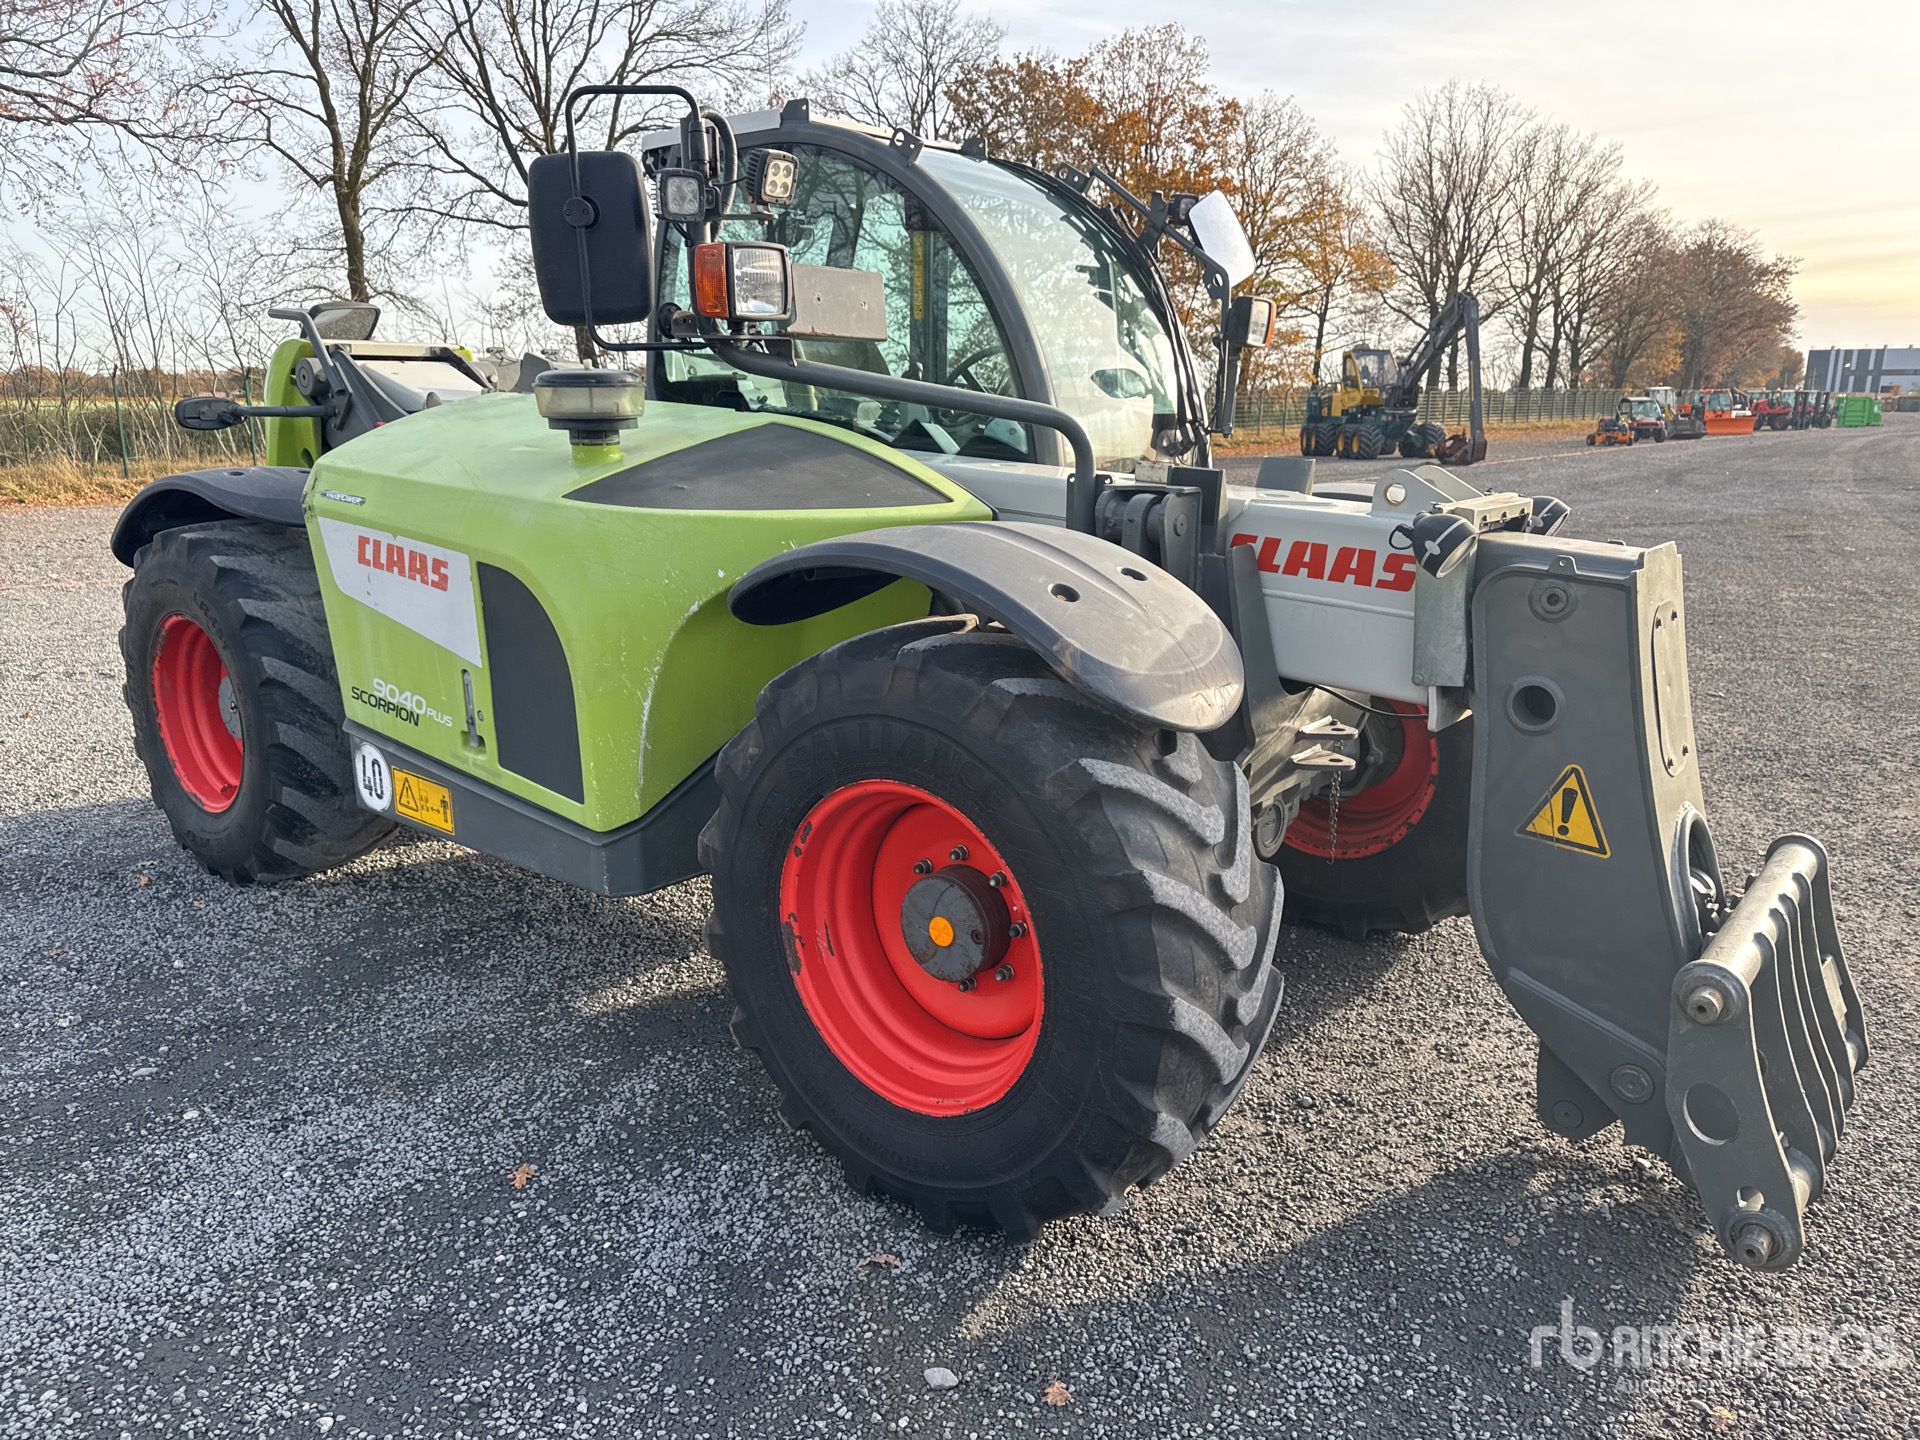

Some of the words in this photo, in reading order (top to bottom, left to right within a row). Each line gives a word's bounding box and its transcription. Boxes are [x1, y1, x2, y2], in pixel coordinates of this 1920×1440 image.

[357, 534, 449, 592] CLAAS
[351, 685, 420, 727] SCORPION
[372, 677, 427, 715] 9040
[426, 706, 453, 728] PLUS
[361, 754, 385, 800] 40
